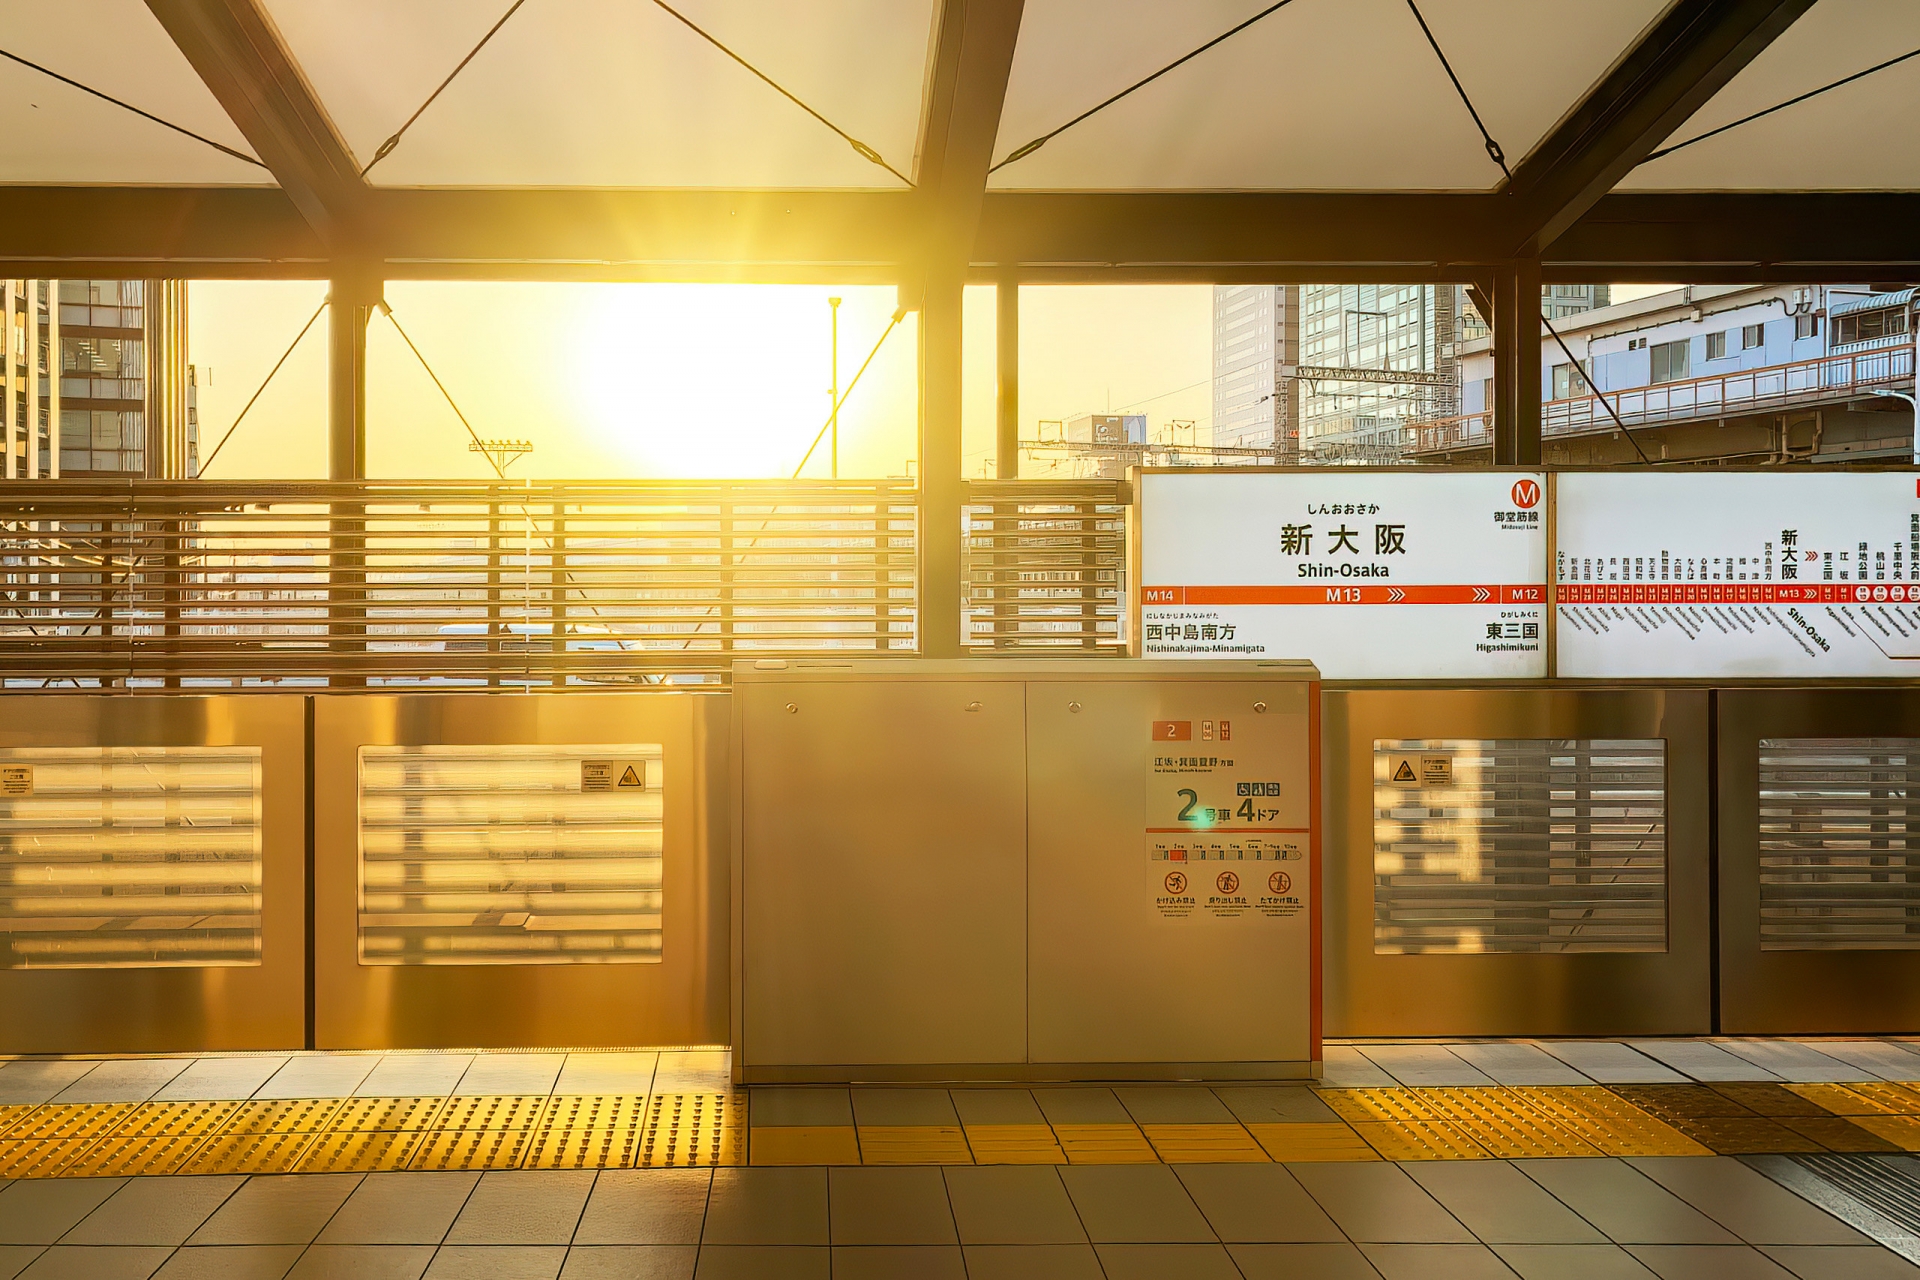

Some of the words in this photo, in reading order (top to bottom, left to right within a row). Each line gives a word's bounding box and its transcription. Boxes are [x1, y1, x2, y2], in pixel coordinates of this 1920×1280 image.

[1515, 482, 1537, 505] M
[1307, 503, 1380, 515] しんおおさか
[1494, 511, 1539, 522] 御堂筋線
[1280, 523, 1406, 556] 新大阪
[1781, 529, 1798, 580] 新大阪
[1858, 542, 1868, 580] 緑地公園
[1893, 542, 1903, 580] 千里中央
[1297, 563, 1389, 578] Shin-Osaka
[1823, 552, 1833, 580] 東三国
[1839, 552, 1849, 580] 江坂
[1876, 552, 1885, 580] 桃山台
[1146, 590, 1173, 601] M14
[1326, 588, 1361, 602] M13
[1512, 589, 1538, 600] M12
[1780, 589, 1799, 598] M13
[1146, 612, 1219, 620] にしなかじまみなみがた
[1146, 623, 1236, 641] 西中島南方
[1486, 622, 1539, 640] 東三国
[1787, 607, 1831, 653] Shin-Osaka
[1146, 644, 1265, 654] Nishinakajima-Minamigata
[1476, 643, 1539, 653] Higashimikuni
[1167, 724, 1176, 737] 2
